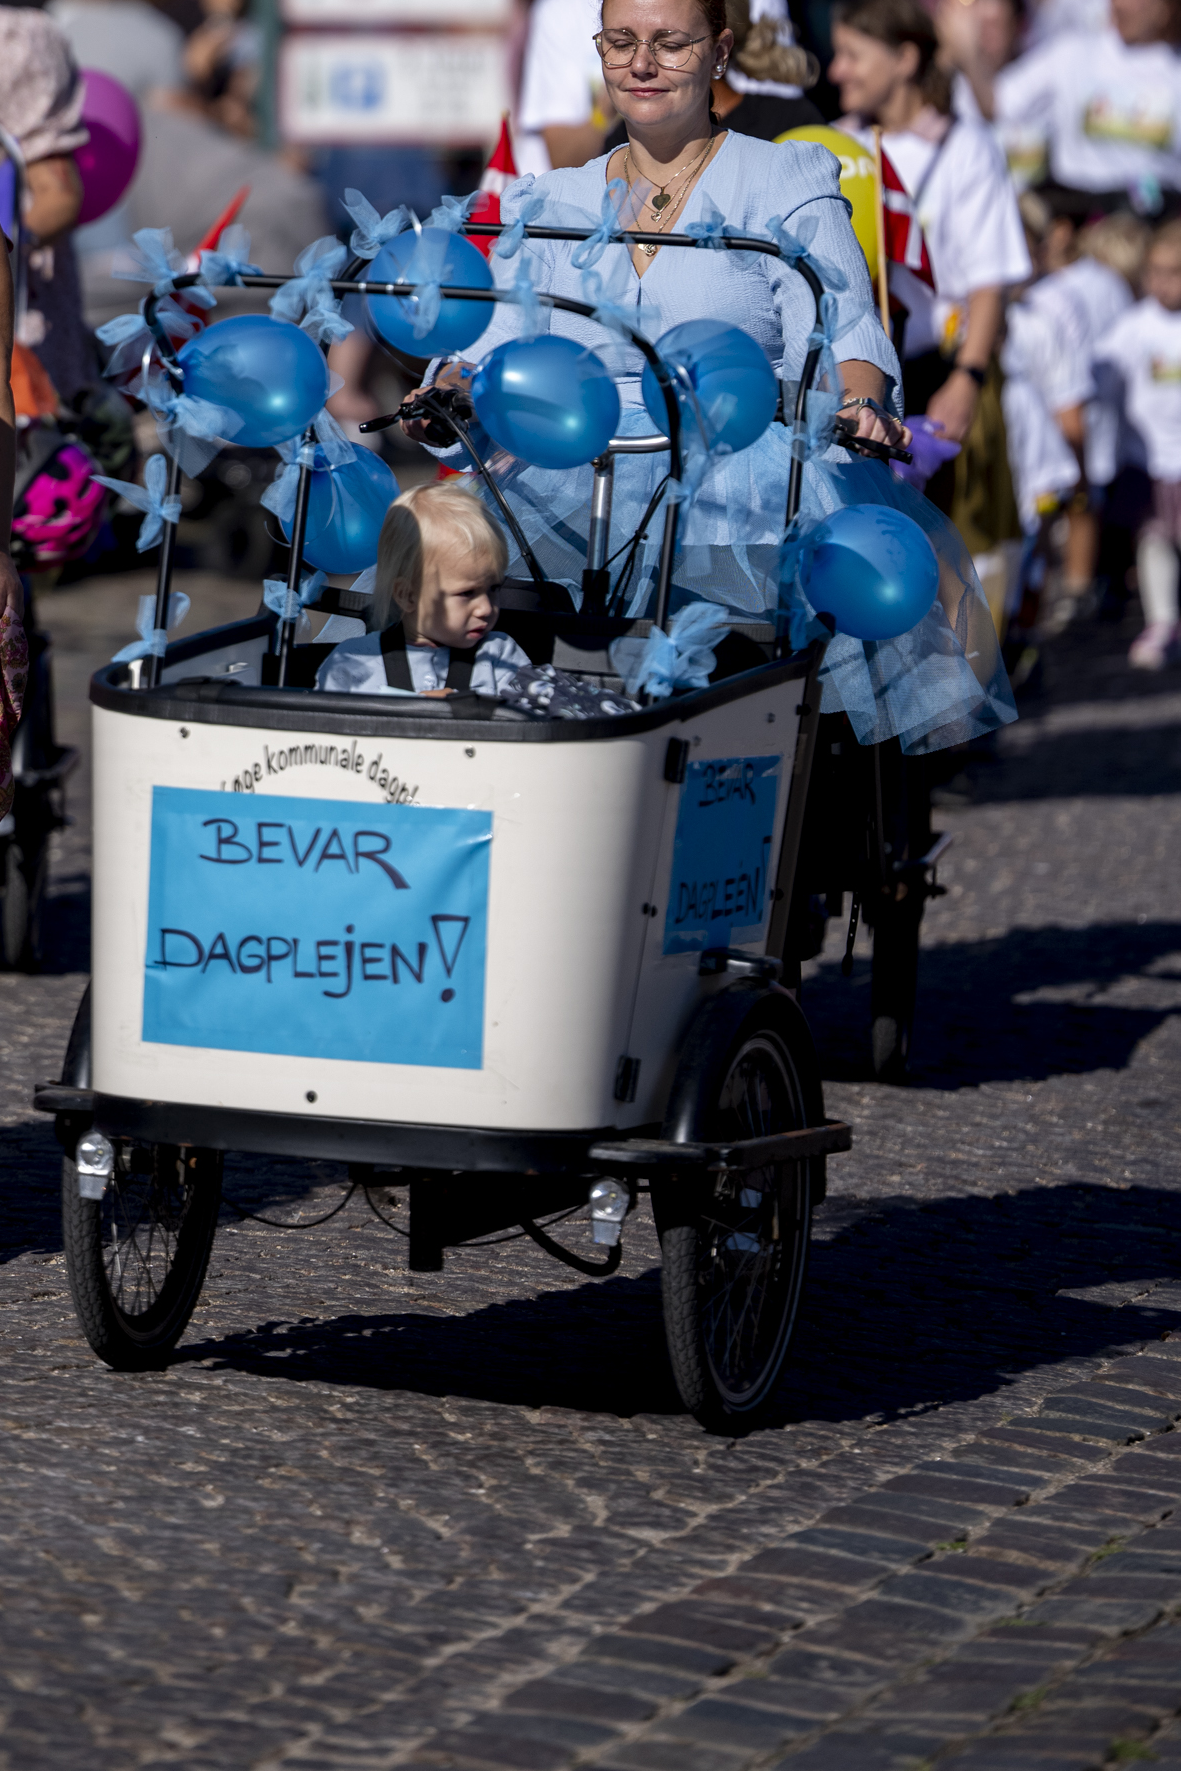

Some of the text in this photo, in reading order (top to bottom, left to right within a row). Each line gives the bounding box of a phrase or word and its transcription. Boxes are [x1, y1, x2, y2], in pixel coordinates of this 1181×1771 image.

[221, 739, 421, 806] øge kommunale dagpl
[199, 817, 411, 890] BEVAR
